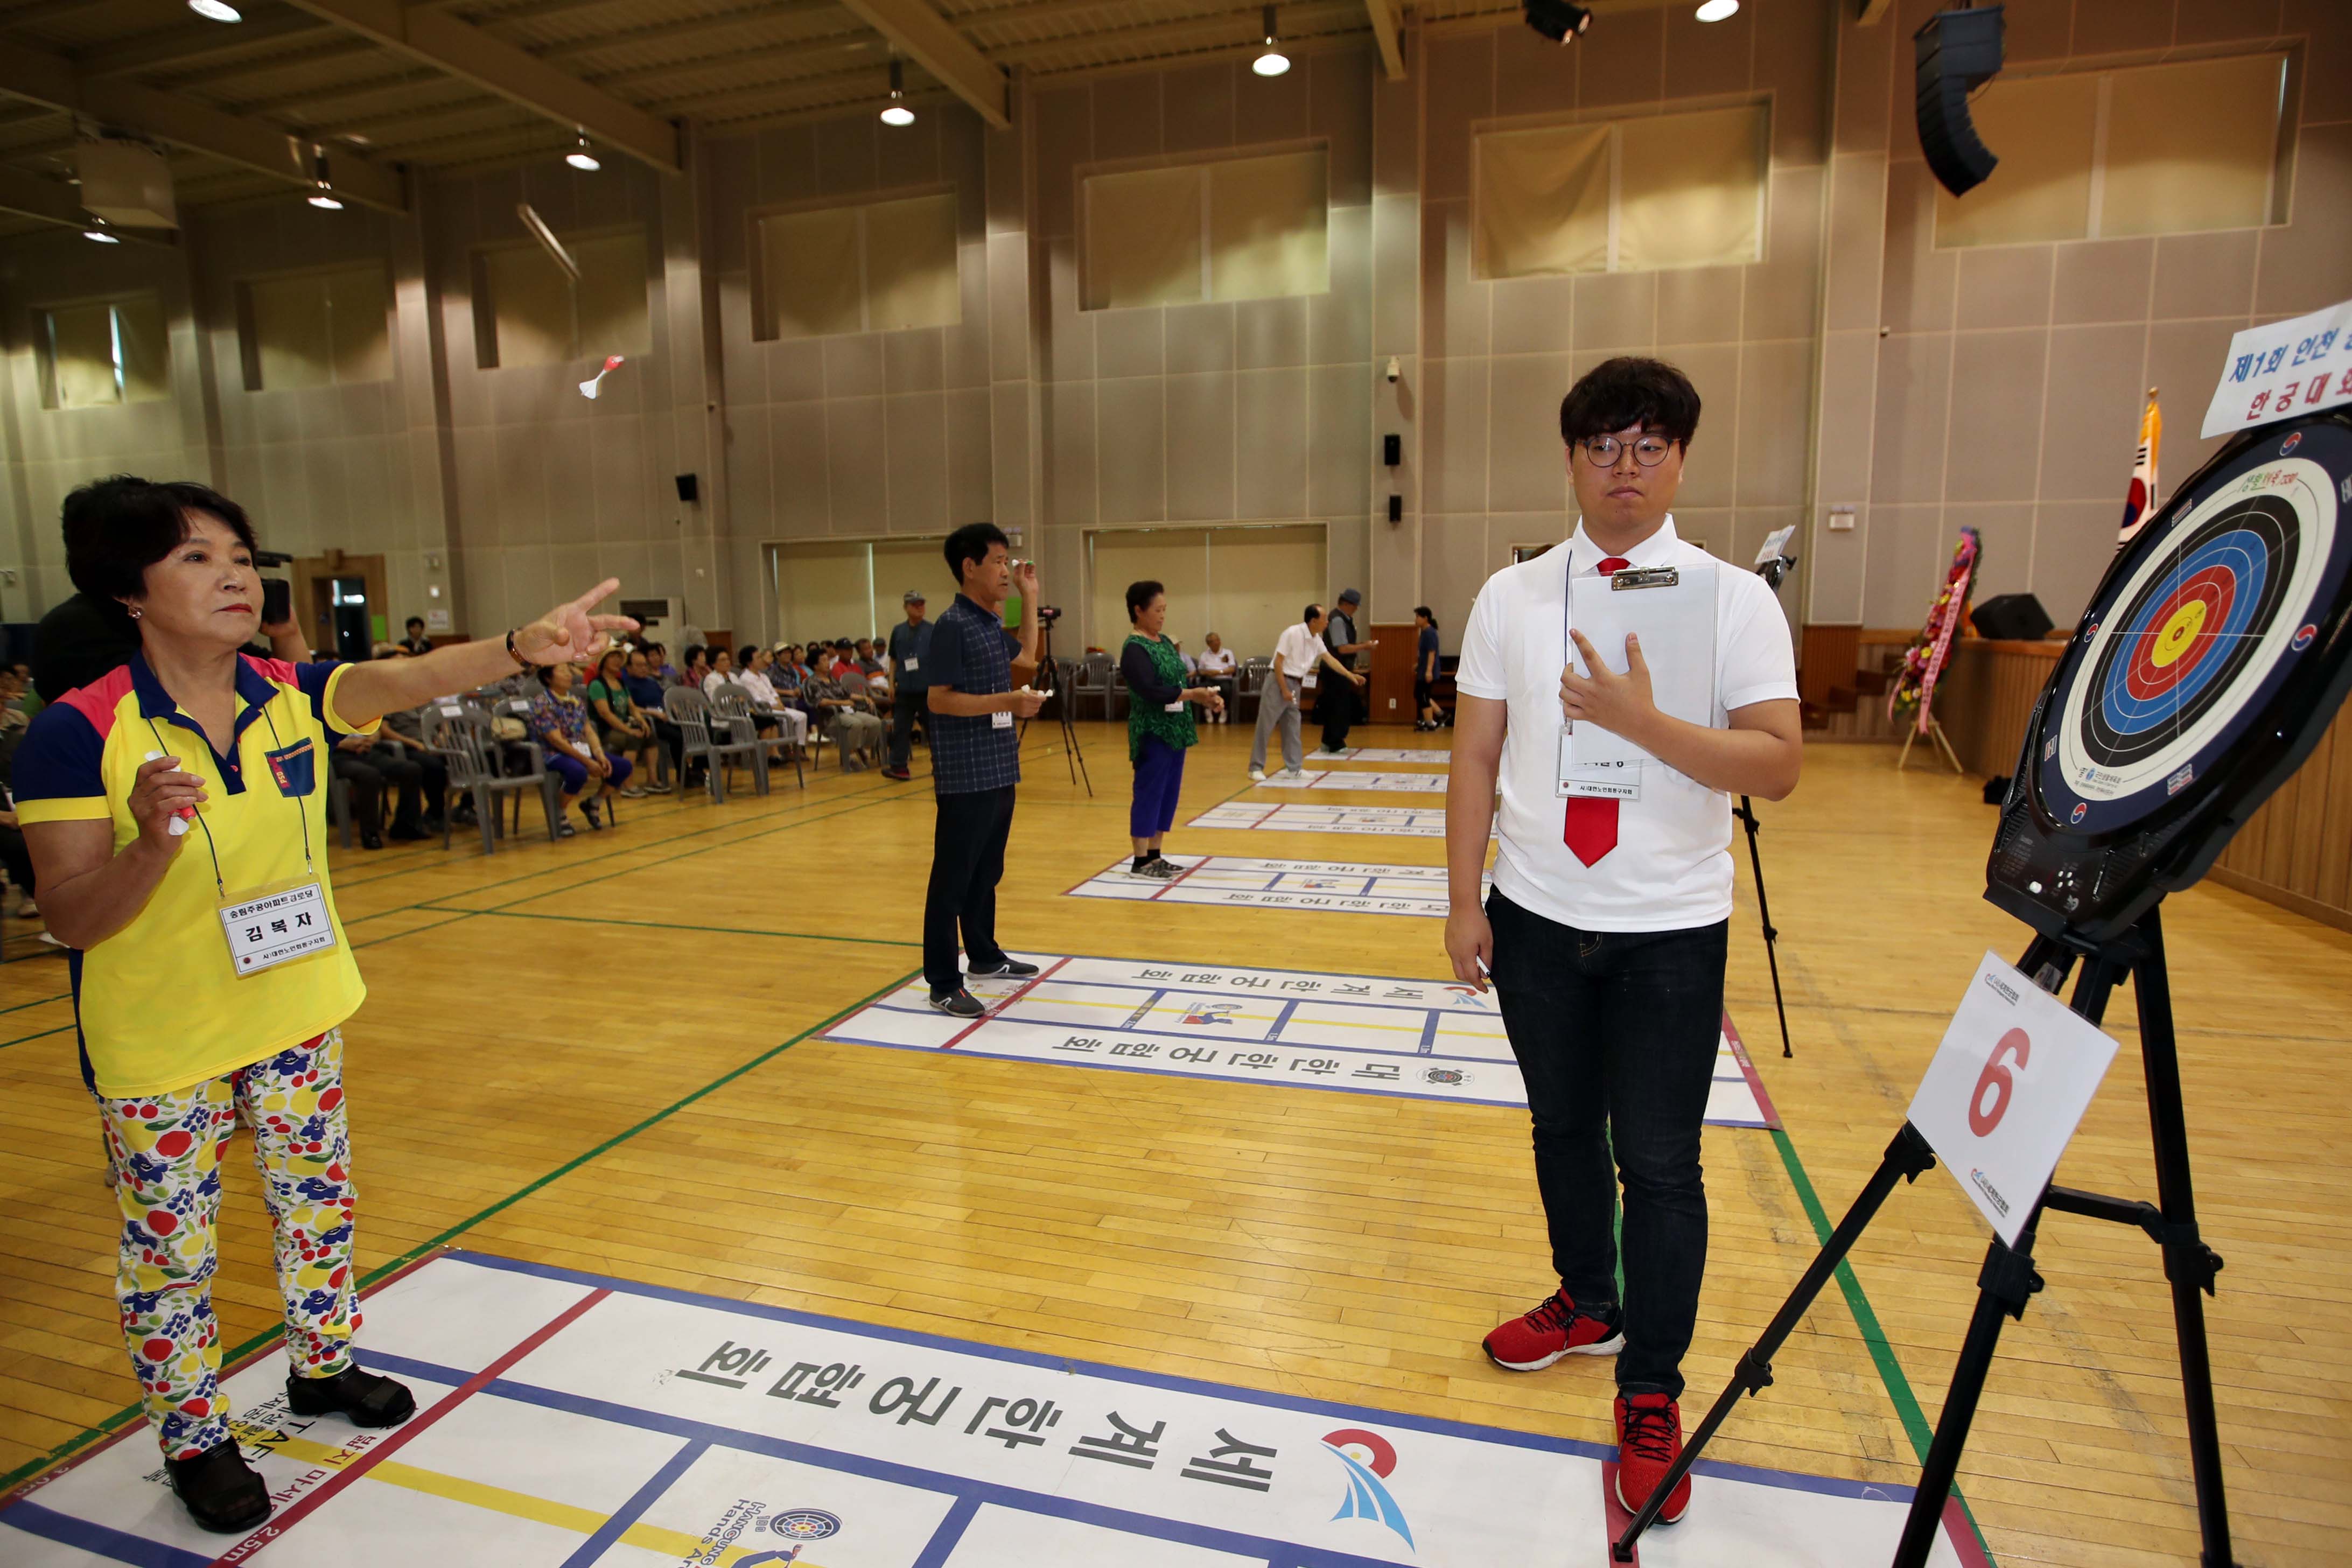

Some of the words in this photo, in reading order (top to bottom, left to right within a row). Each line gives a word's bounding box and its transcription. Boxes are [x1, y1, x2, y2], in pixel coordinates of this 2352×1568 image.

[2229, 343, 2289, 383] 제1회
[2291, 327, 2340, 368] 인천
[1968, 1027, 2031, 1138] 6
[223, 1526, 280, 1562] 2.5m
[701, 1499, 750, 1544] Hands
